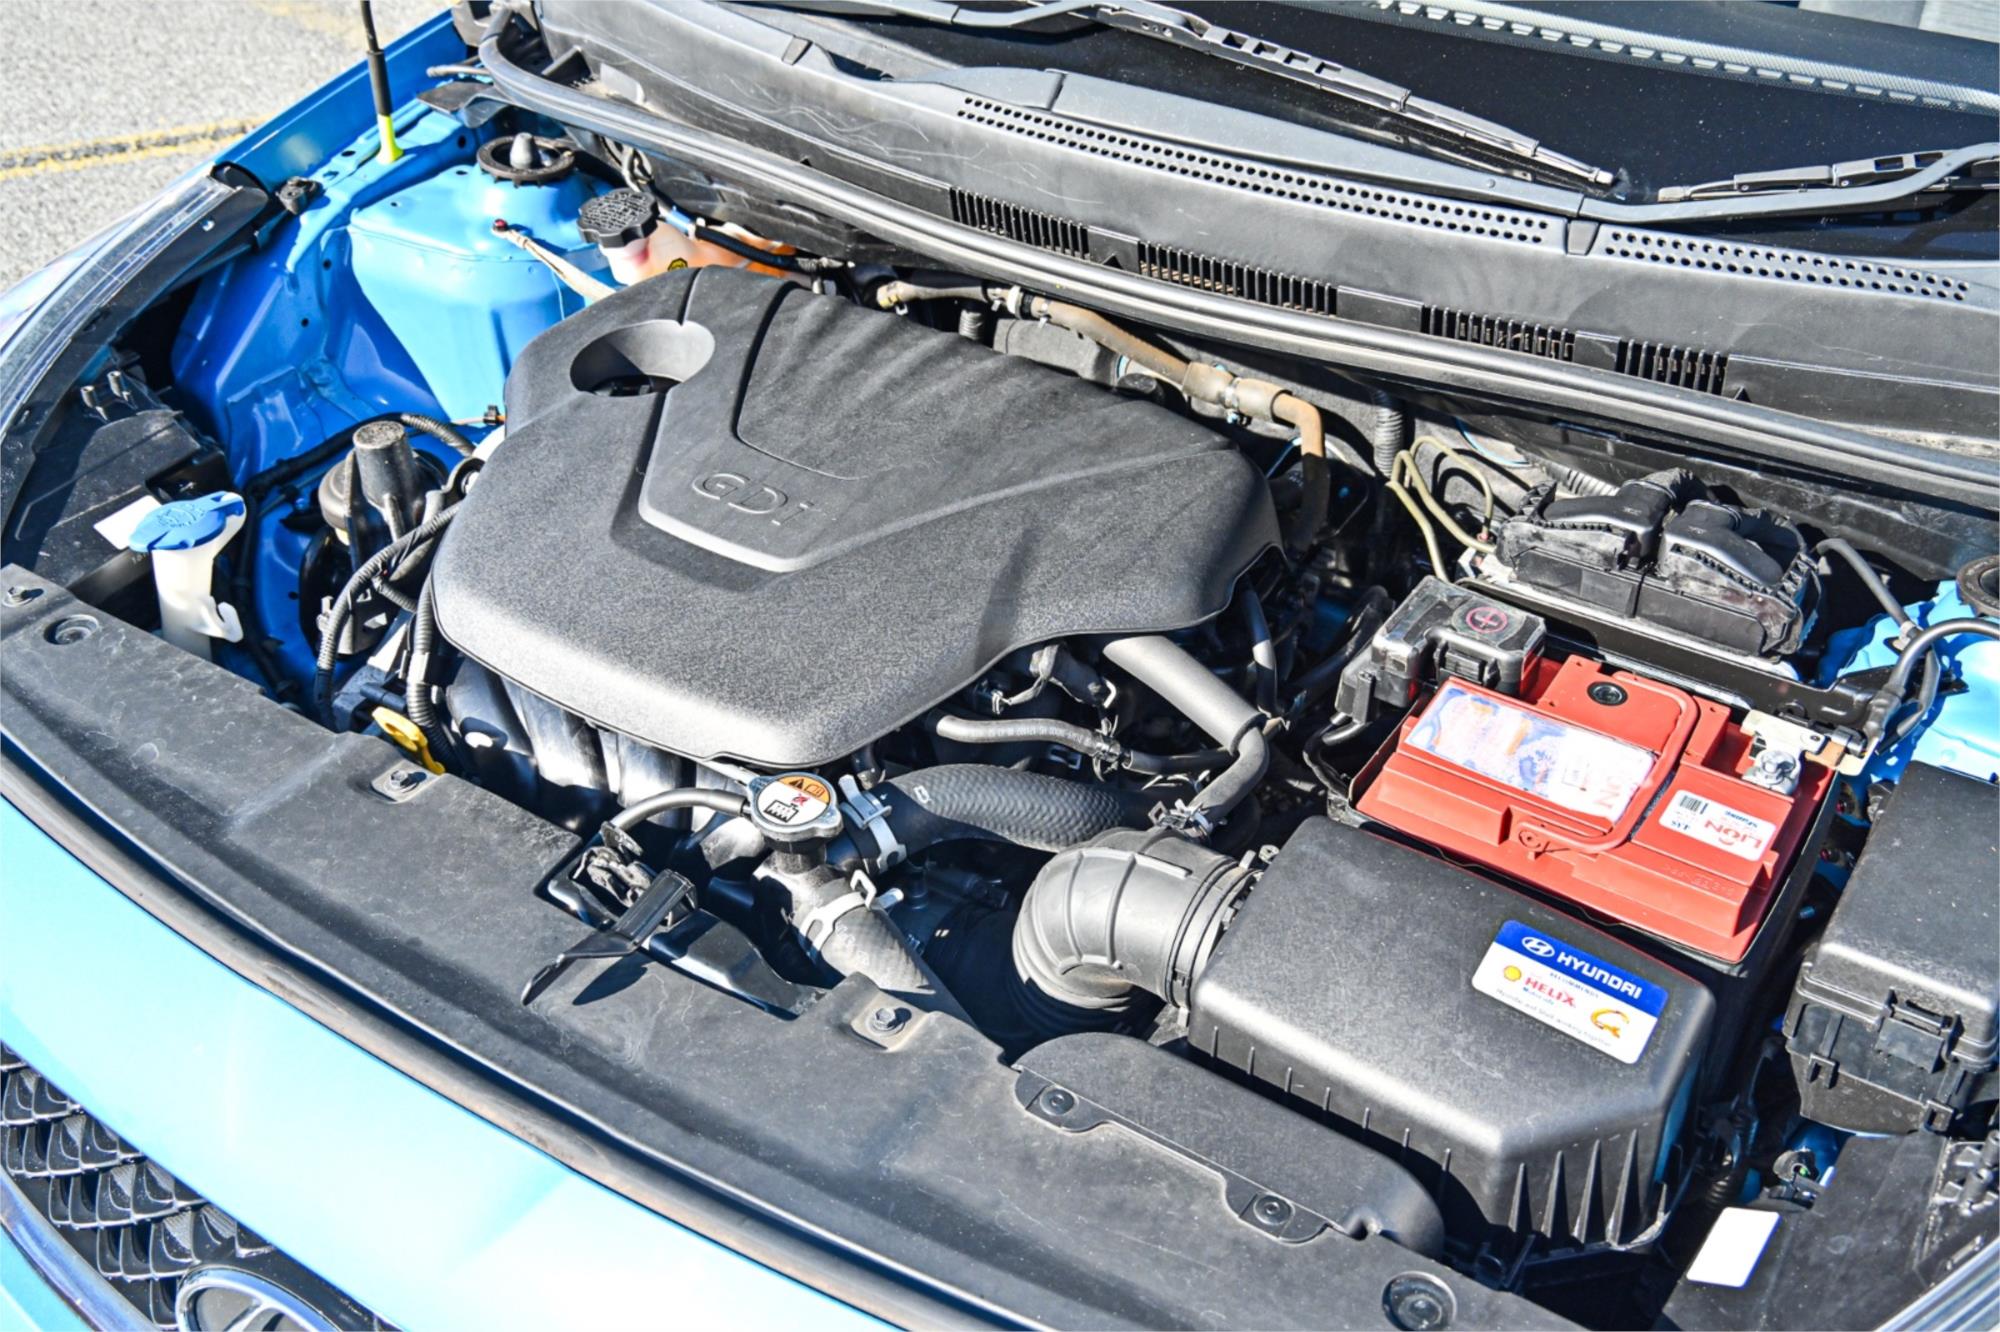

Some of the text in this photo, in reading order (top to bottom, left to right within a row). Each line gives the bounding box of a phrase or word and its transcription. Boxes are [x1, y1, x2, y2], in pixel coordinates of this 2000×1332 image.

[691, 472, 817, 527] GDI
[1704, 819, 1763, 849] LION
[1525, 976, 1575, 1007] HELIX
[1557, 951, 1643, 1000] HYUNDAI
